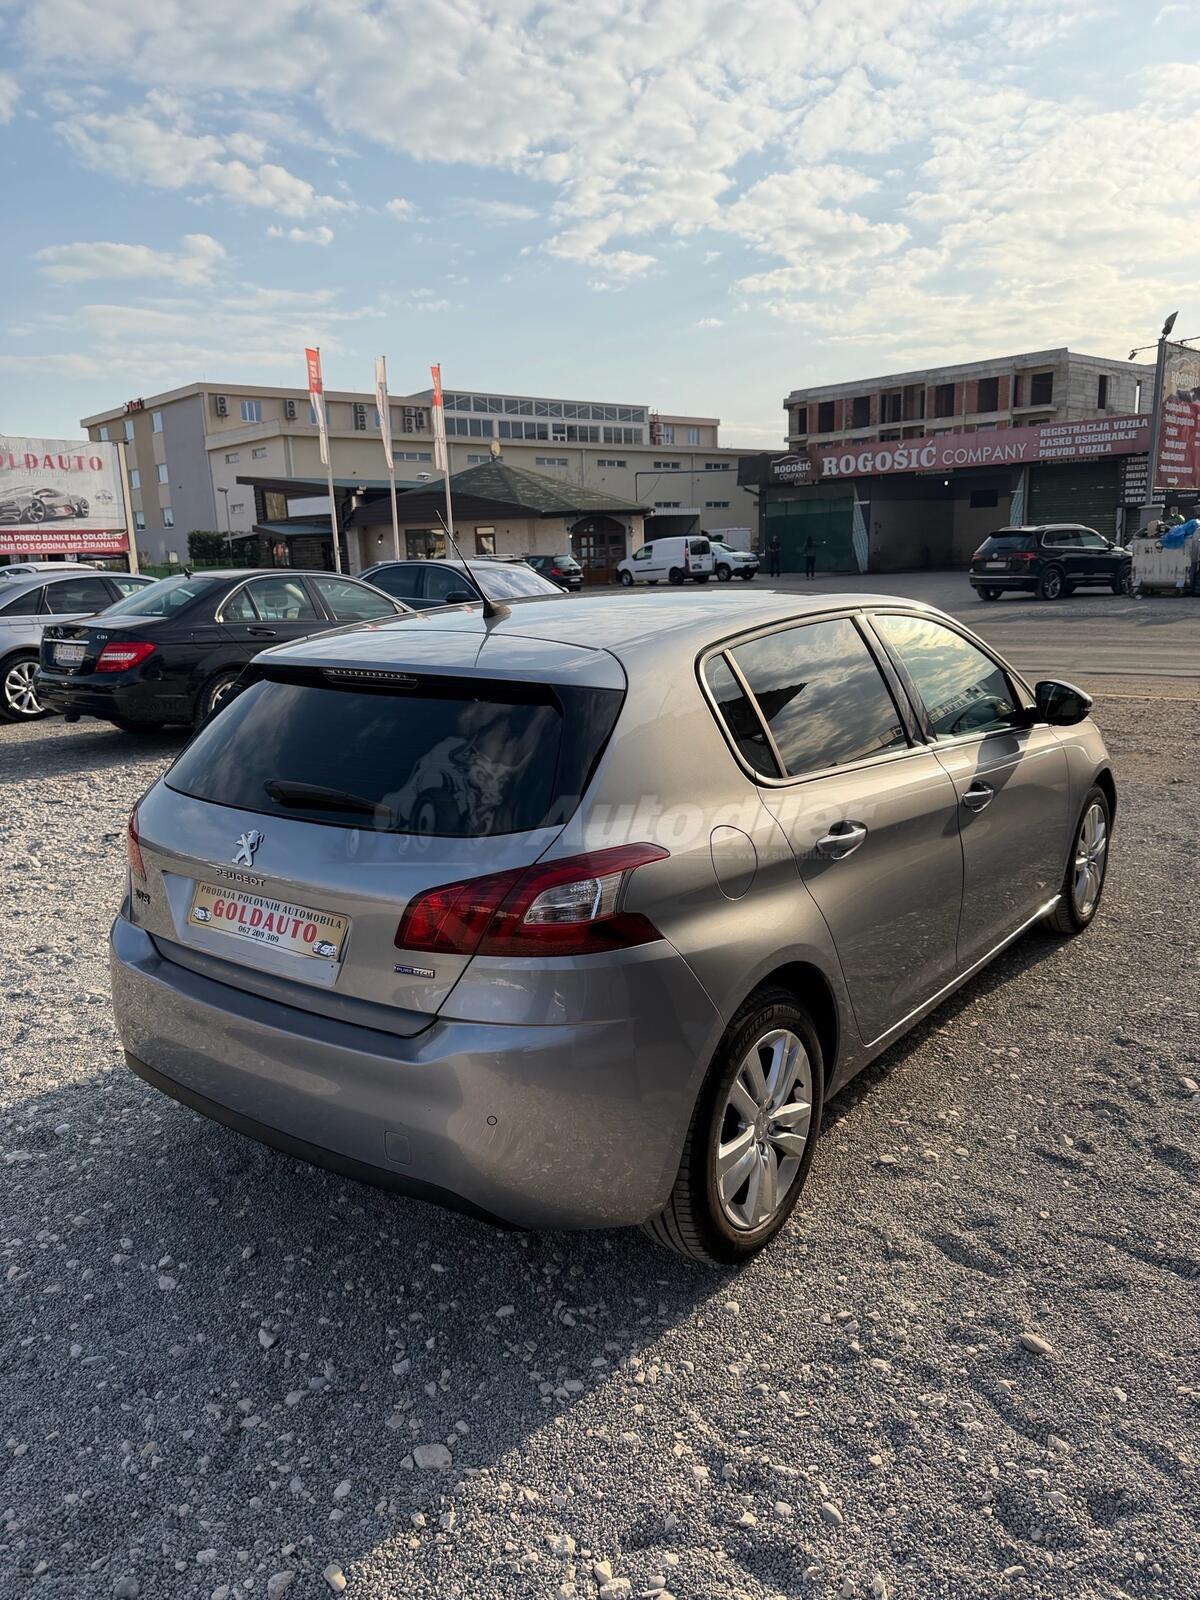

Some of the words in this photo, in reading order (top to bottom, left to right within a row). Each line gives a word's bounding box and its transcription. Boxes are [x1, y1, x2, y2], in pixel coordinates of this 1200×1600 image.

[1040, 423, 1110, 437] REGISTRACIJA
[1113, 419, 1148, 430] VOZILA
[1040, 436, 1072, 447] KASKO
[1075, 430, 1137, 444] OSIGURANJE
[821, 440, 937, 476] ROGOŠIĆ
[942, 443, 1027, 465] COMPANY
[1039, 446, 1076, 457] PREVOD
[1079, 443, 1112, 454] VOZILA
[779, 472, 807, 480] COMPANY
[36, 542, 67, 550] GODINA
[215, 869, 266, 887] PEUGEOT
[200, 885, 236, 900] PRODAJA
[238, 894, 281, 912] POLOVNIH
[281, 905, 341, 929] AUTOMOBILA
[213, 899, 318, 943] GOLDAUTO
[237, 925, 250, 934] 067
[251, 929, 265, 938] 209
[266, 933, 280, 943] 309
